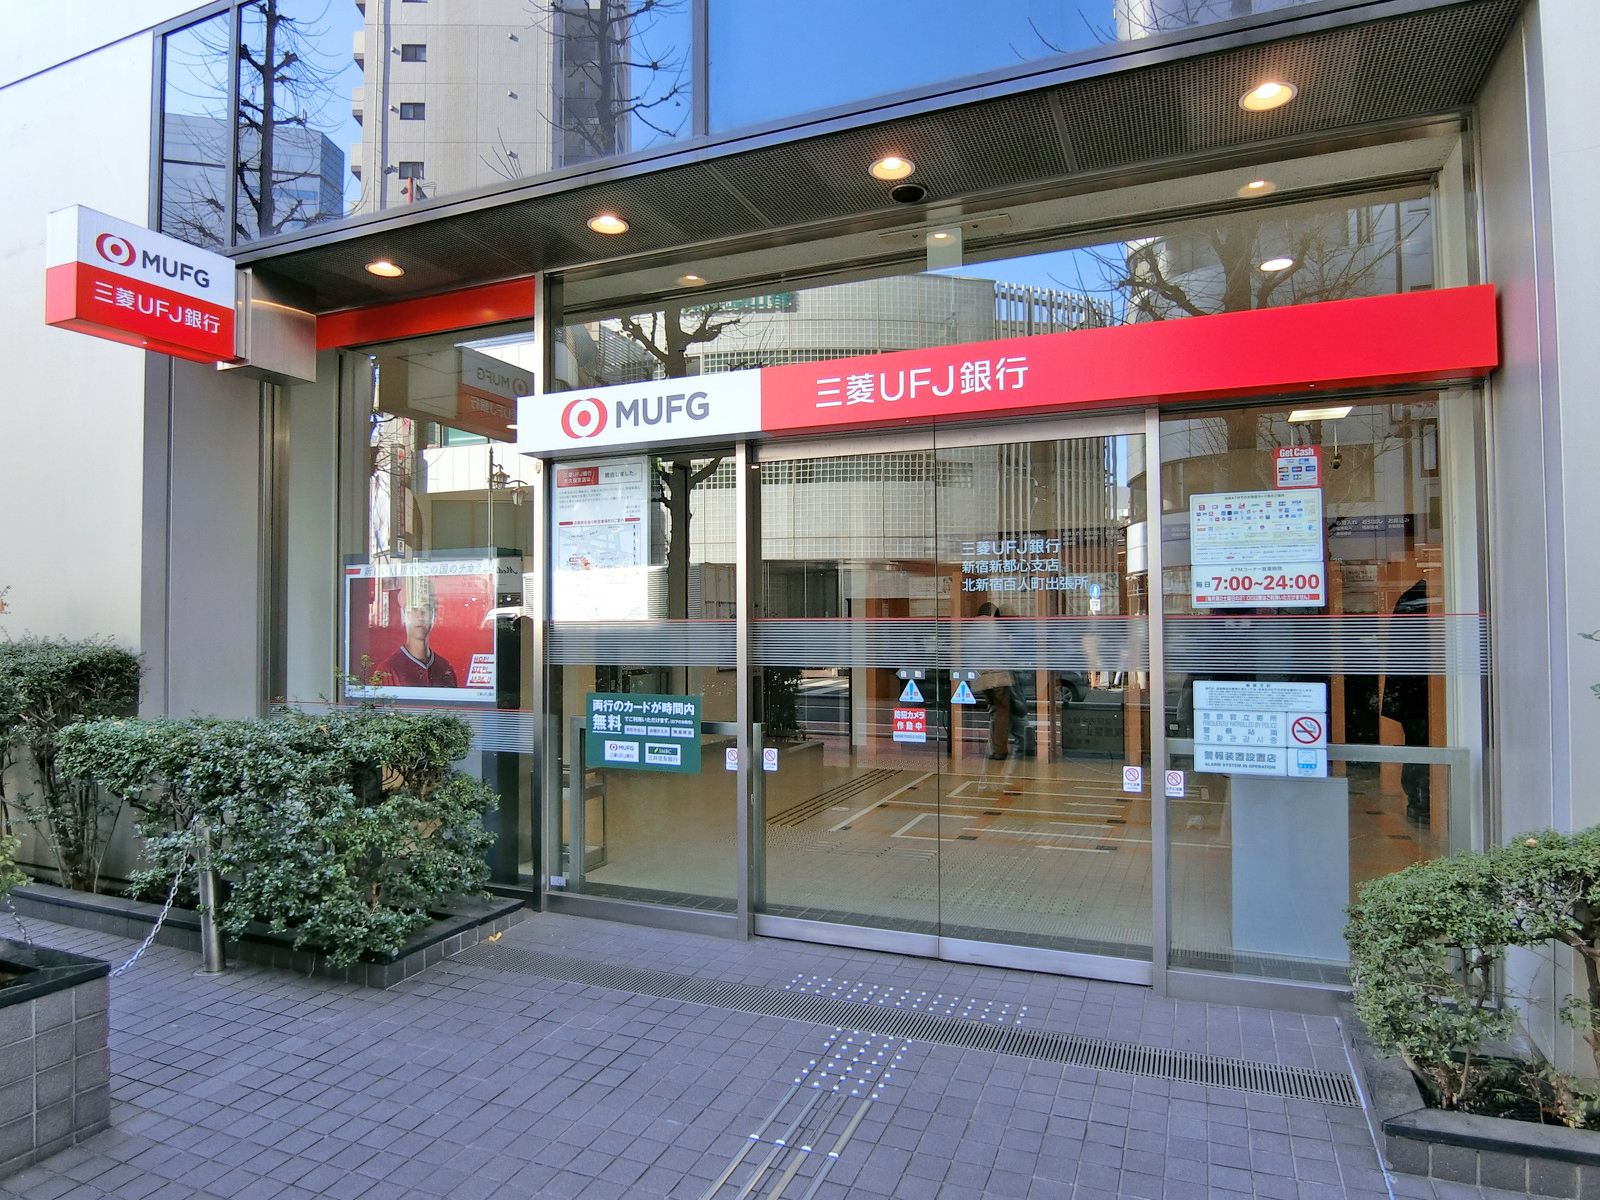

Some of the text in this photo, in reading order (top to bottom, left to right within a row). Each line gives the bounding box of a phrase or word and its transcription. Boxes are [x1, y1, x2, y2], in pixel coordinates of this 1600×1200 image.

[142, 250, 210, 288] MUFG
[93, 280, 221, 335] 三菱UFJ銀行
[814, 356, 1029, 409] 三菱UFJ銀行
[615, 391, 709, 429] MUFG
[1280, 447, 1314, 457] Get Cash
[961, 538, 1061, 556] 三菱UFJ銀行
[961, 558, 1060, 574] 新宿新都心支店
[961, 575, 1089, 592] 北新宿百人町出張所
[592, 699, 695, 716] 両行のカードが時間内
[894, 711, 925, 720] 防犯カメラ
[592, 713, 622, 732] 無料
[1203, 712, 1278, 722] 警察官立寄所
[897, 721, 923, 730] 作動中
[618, 744, 635, 752] MUFG
[658, 747, 673, 755] SMBC
[647, 755, 679, 763] 三井住友銀行
[1204, 750, 1277, 763] 警報装置設置店
